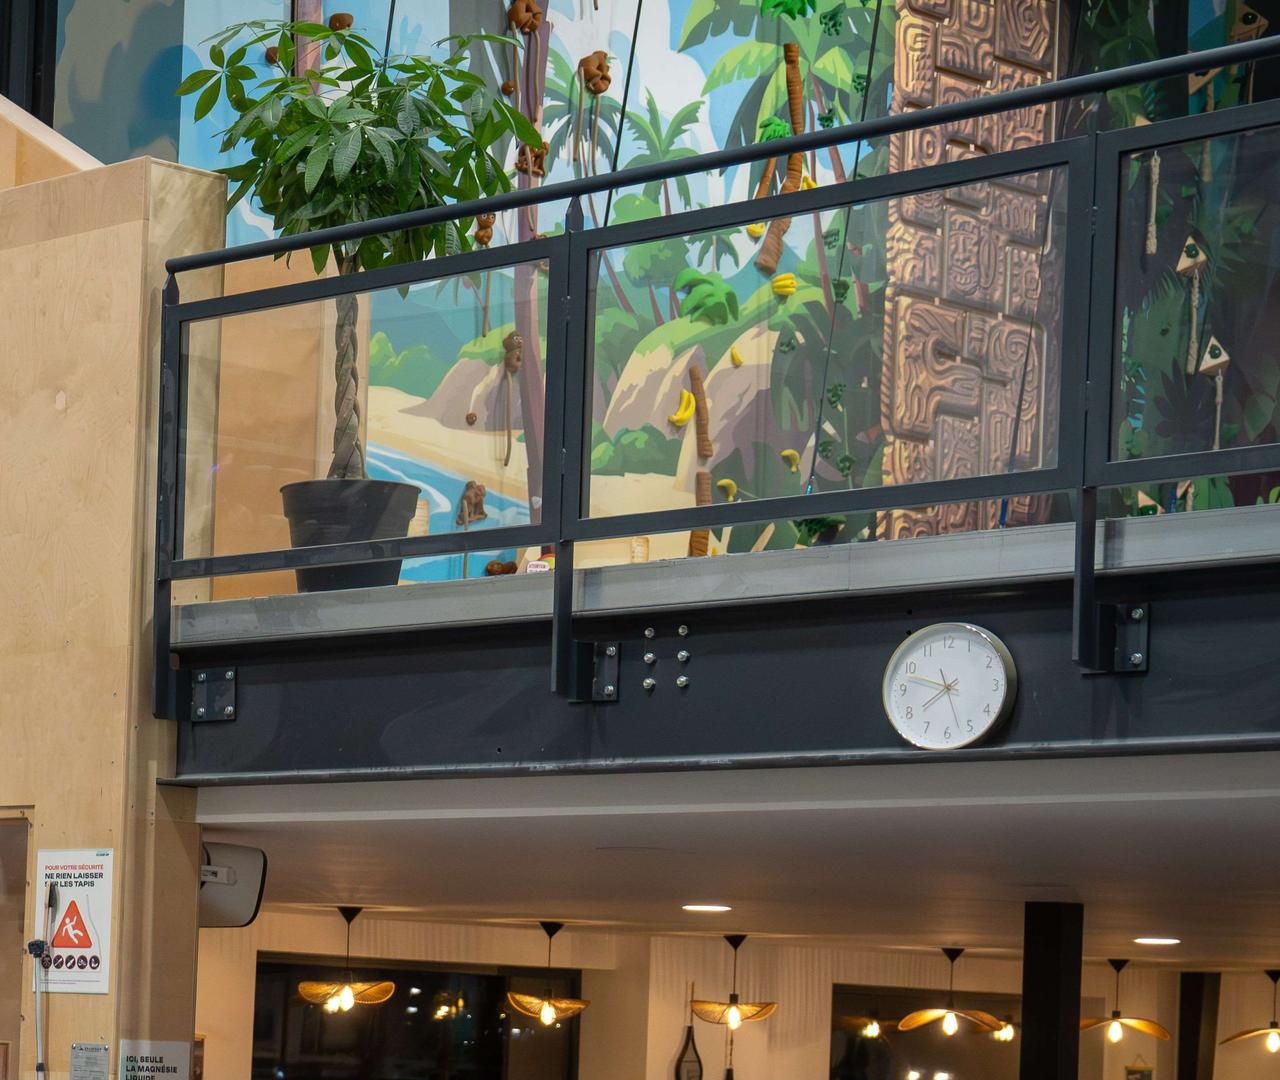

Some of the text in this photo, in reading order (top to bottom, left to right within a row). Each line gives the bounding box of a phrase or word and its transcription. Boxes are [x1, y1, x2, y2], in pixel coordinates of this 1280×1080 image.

[943, 636, 954, 649] 12
[967, 640, 971, 653] 1
[922, 645, 932, 657] 11
[905, 661, 916, 674] 10
[985, 656, 992, 669] 2
[900, 683, 907, 696] 9
[992, 679, 999, 692] 3
[906, 706, 913, 719] 8
[983, 704, 991, 716] 4
[923, 721, 930, 734] 7
[967, 720, 974, 732] 5
[944, 727, 951, 739] 6
[44, 872, 55, 880] NE
[44, 880, 59, 888] SR
[60, 880, 73, 888] LES
[126, 1055, 164, 1064] ICI, SEULE
[125, 1064, 178, 1074] LA MAGNÉSIE
